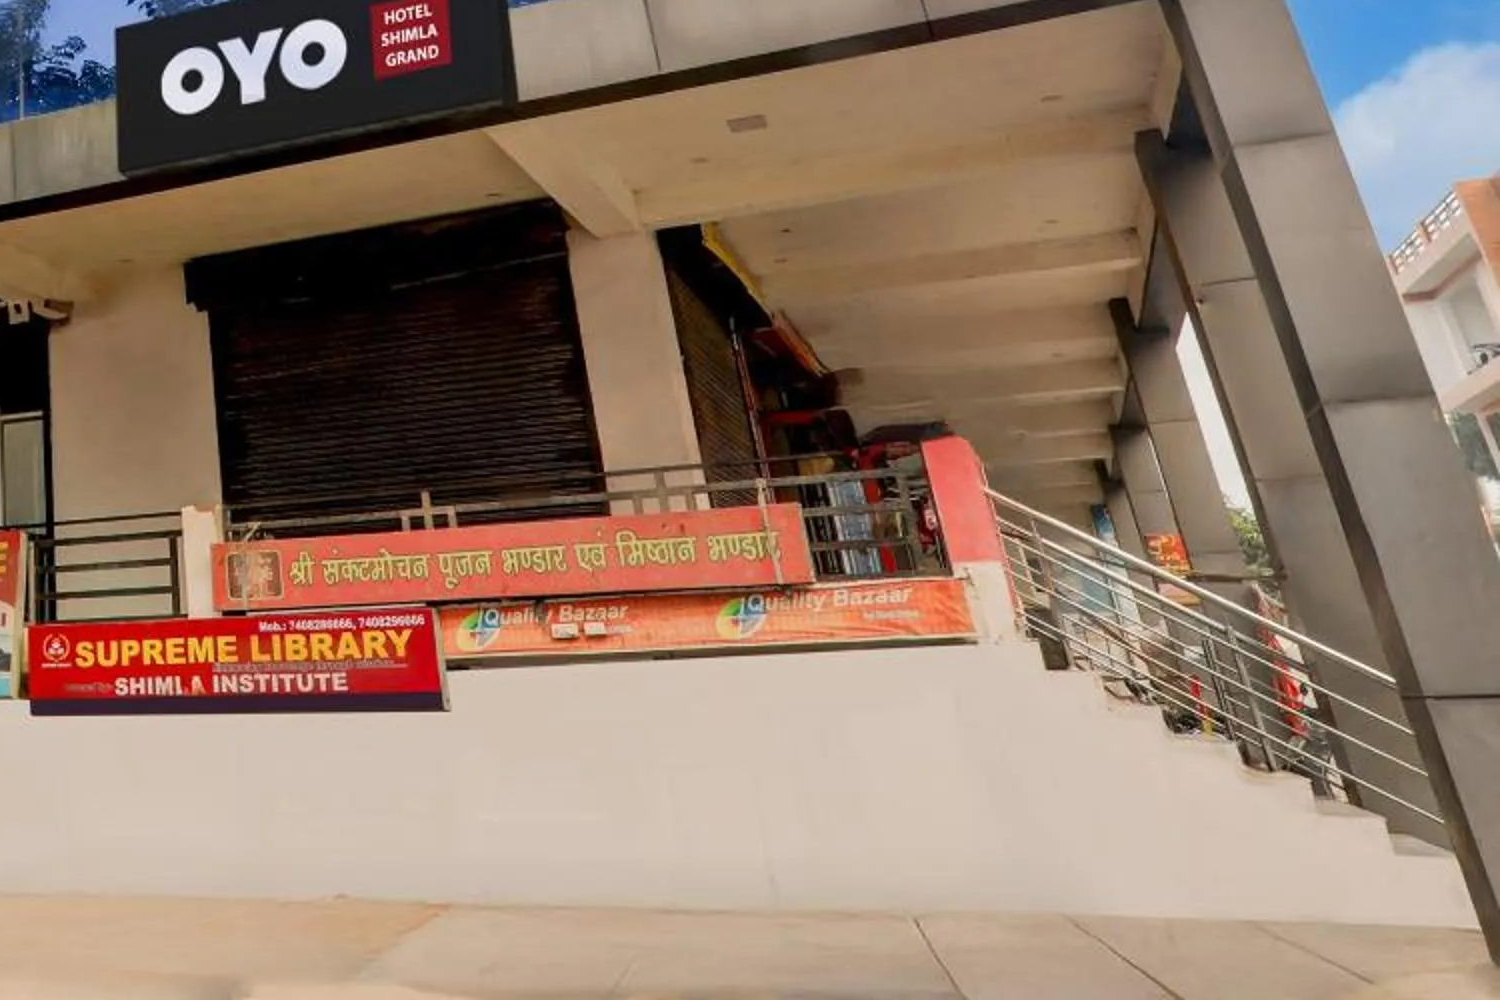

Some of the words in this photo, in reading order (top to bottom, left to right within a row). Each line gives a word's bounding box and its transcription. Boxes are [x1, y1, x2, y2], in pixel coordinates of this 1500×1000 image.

[383, 3, 433, 26] HOTEL
[381, 24, 438, 48] SHIMLA
[160, 18, 348, 116] OYO
[385, 45, 440, 68] GRAND
[289, 551, 315, 585] श्री
[436, 550, 492, 589] पूजन
[748, 593, 825, 613] Quality
[833, 586, 914, 608] Bazaar
[559, 603, 629, 623] Bazaar
[75, 634, 239, 668] SUPREME
[250, 628, 413, 662] LIBRARY
[211, 671, 349, 694] INSTITUTE
